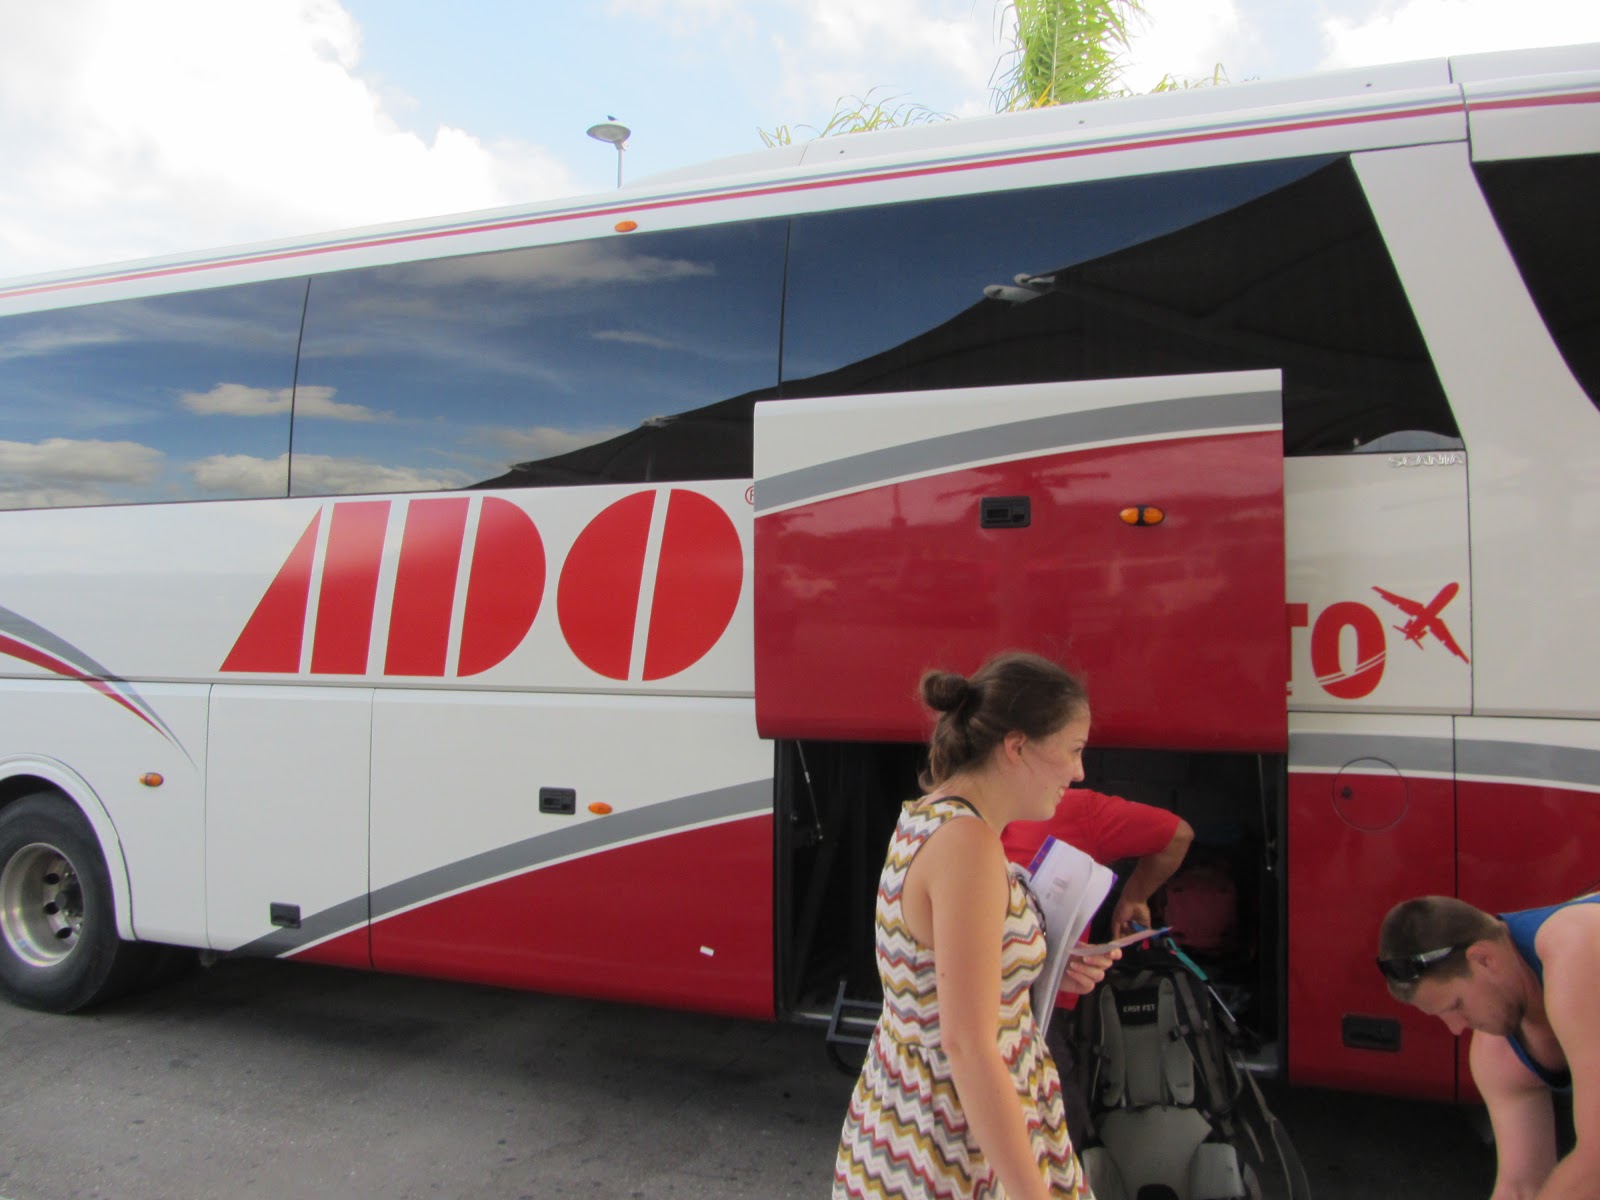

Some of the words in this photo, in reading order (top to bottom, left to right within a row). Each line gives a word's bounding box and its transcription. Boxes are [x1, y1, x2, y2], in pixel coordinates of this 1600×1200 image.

[1387, 454, 1464, 468] SCANIA
[218, 488, 744, 682] ADO
[1142, 1003, 1156, 1012] FIT
